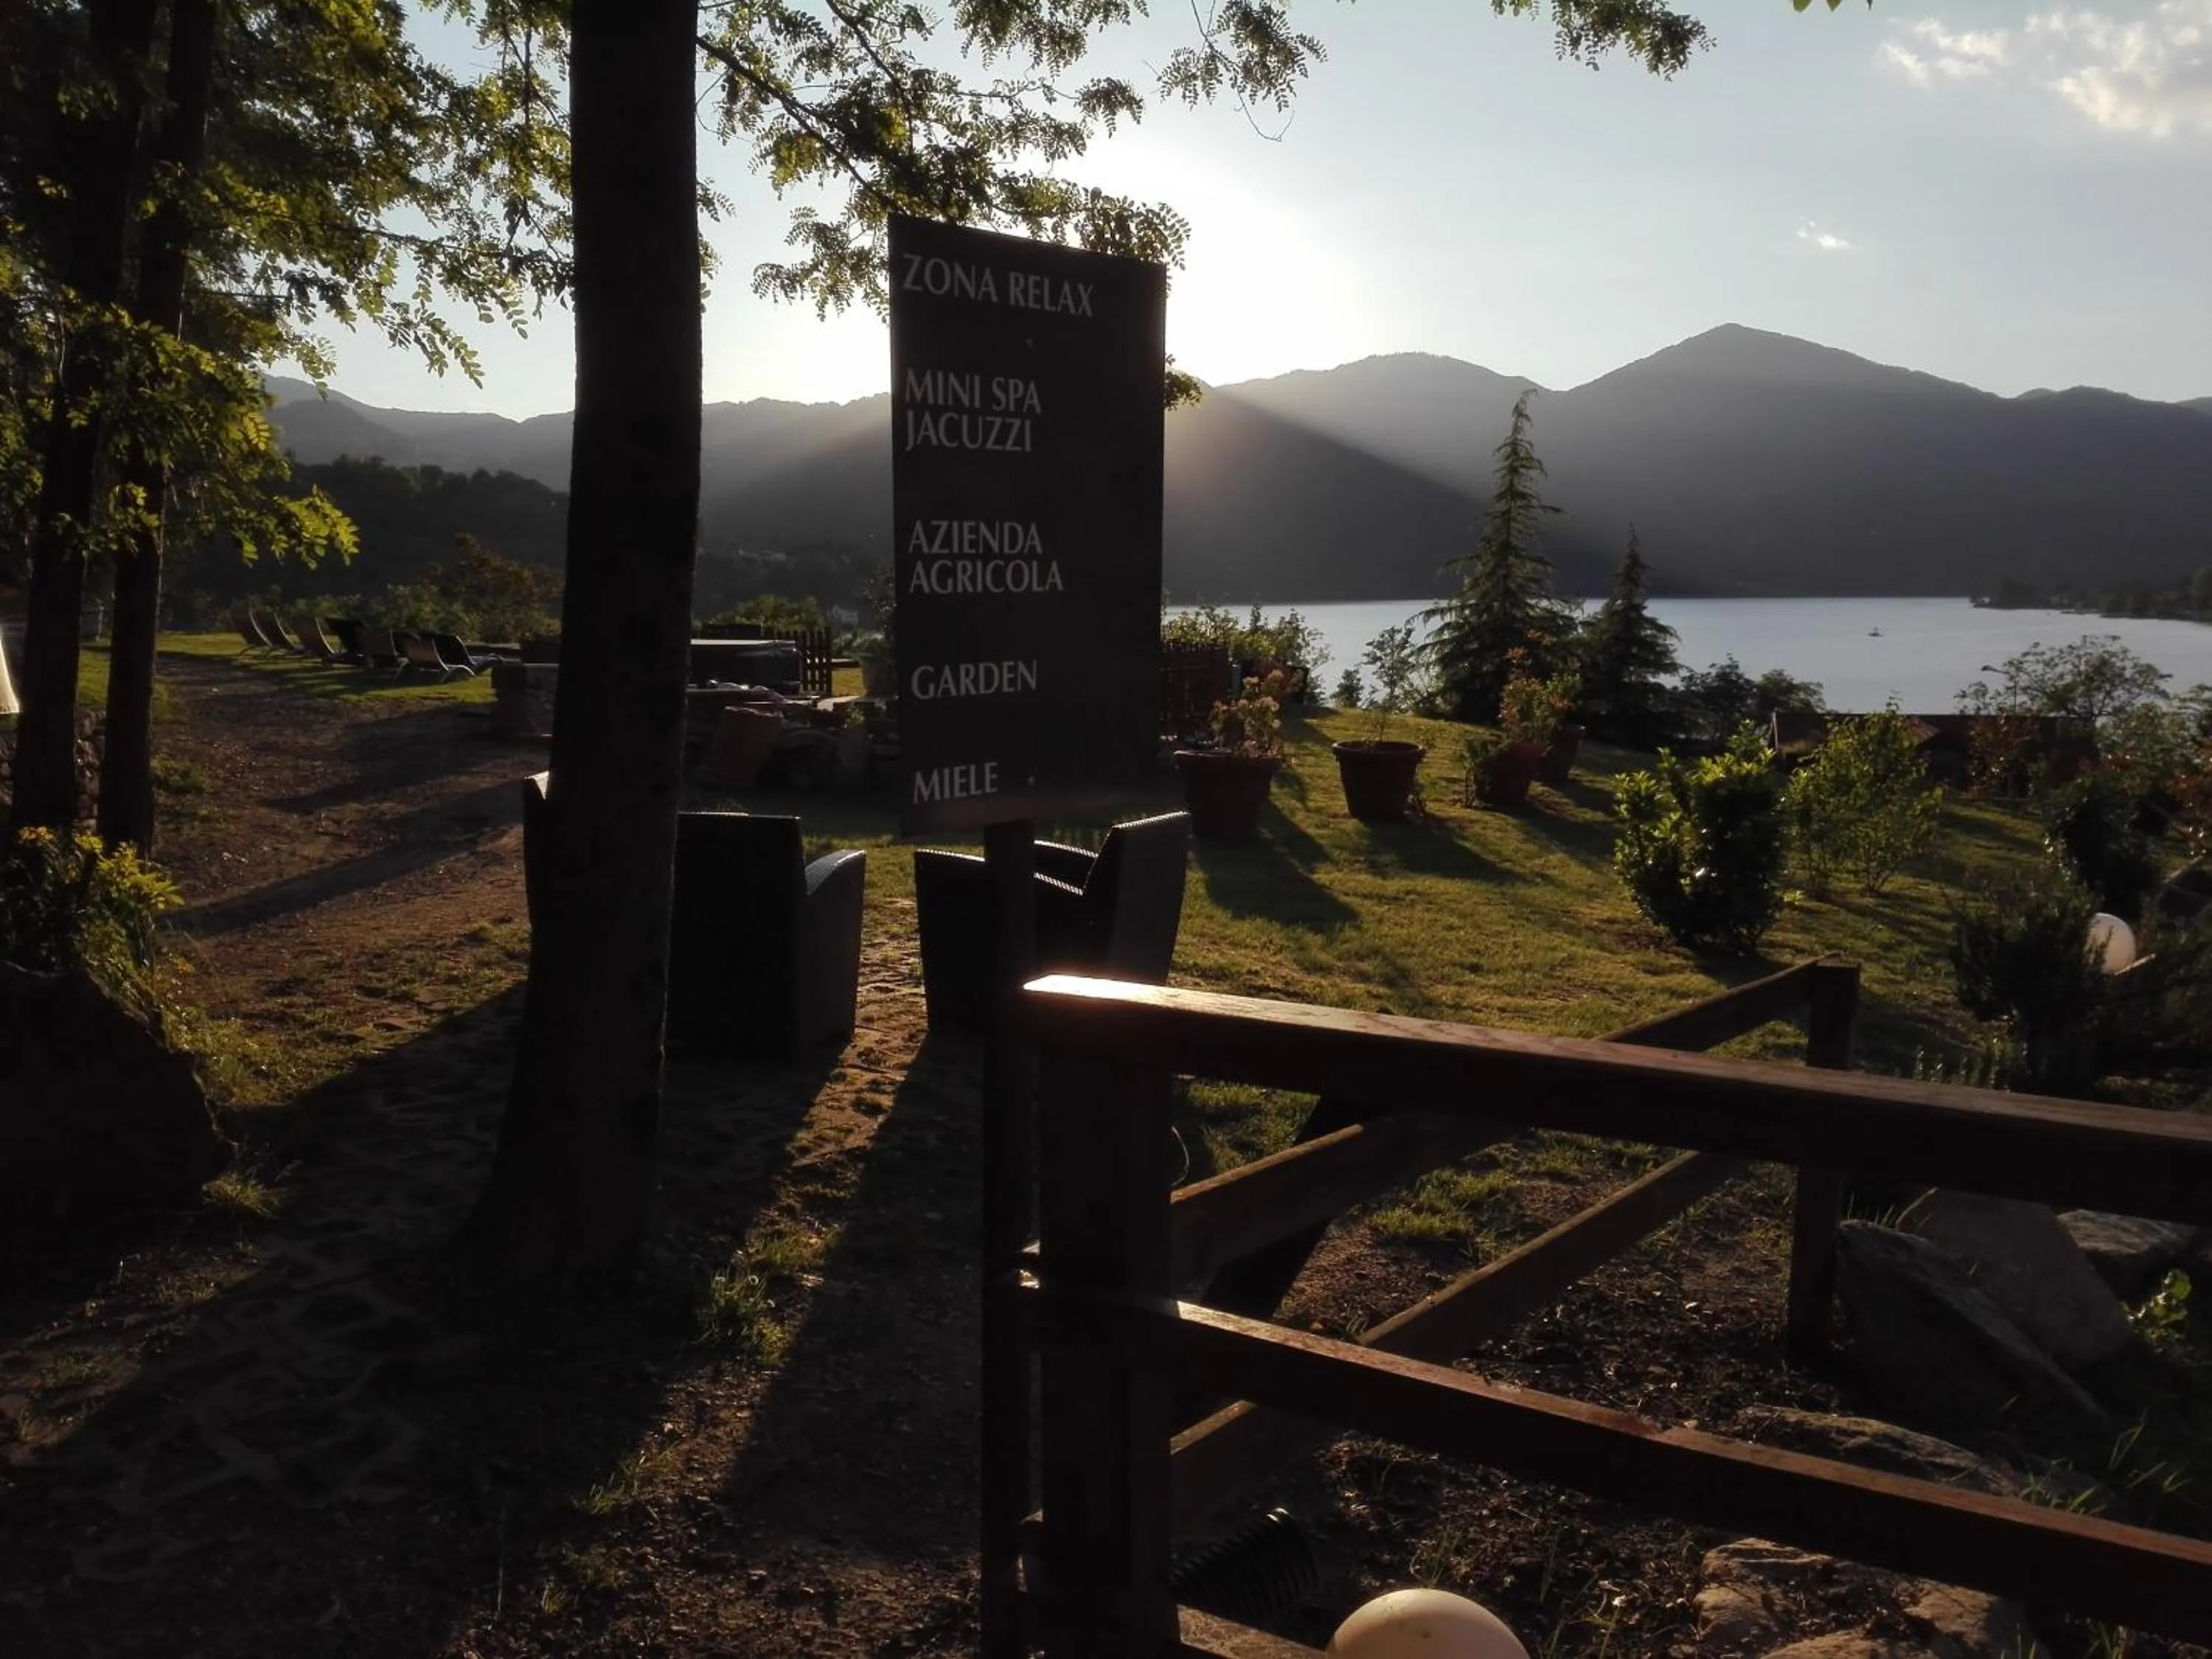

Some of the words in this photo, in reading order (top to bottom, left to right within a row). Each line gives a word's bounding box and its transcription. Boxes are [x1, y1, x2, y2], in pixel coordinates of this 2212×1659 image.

[902, 253, 998, 304] ZONA
[1009, 271, 1094, 317] RELAX
[905, 369, 981, 408] MINI
[992, 377, 1043, 414] SPA
[905, 409, 1032, 452] JACUZZI
[908, 520, 1043, 554] AZIENDA
[908, 559, 1065, 594] AGRICOLA
[911, 660, 1037, 700] GARDEN
[913, 762, 998, 804] MIELE
